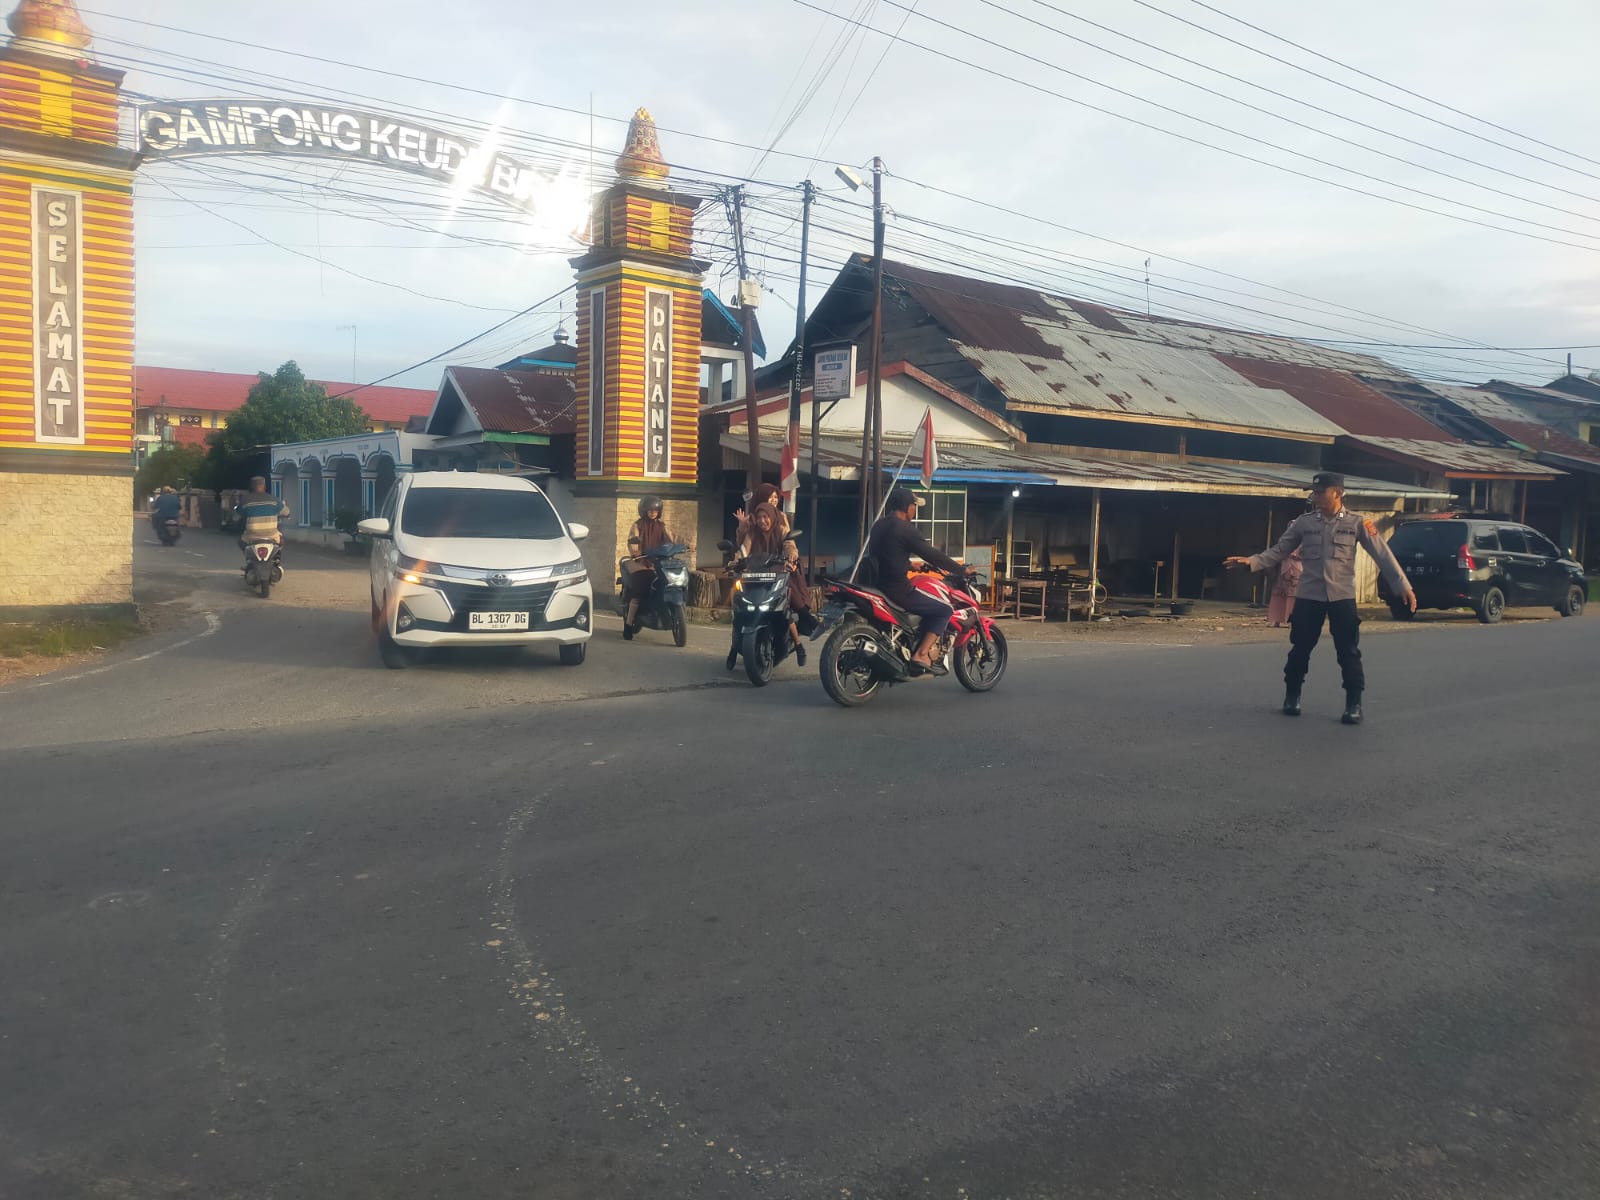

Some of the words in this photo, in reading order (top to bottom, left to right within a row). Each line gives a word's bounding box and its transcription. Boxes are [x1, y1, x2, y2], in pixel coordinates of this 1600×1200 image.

[139, 105, 361, 151] GAMPONG
[370, 119, 484, 181] KEUD
[46, 201, 74, 425] SELAMAT
[651, 306, 666, 455] DATANG
[472, 614, 483, 624] BL
[488, 614, 511, 624] 1307
[514, 614, 526, 624] DG
